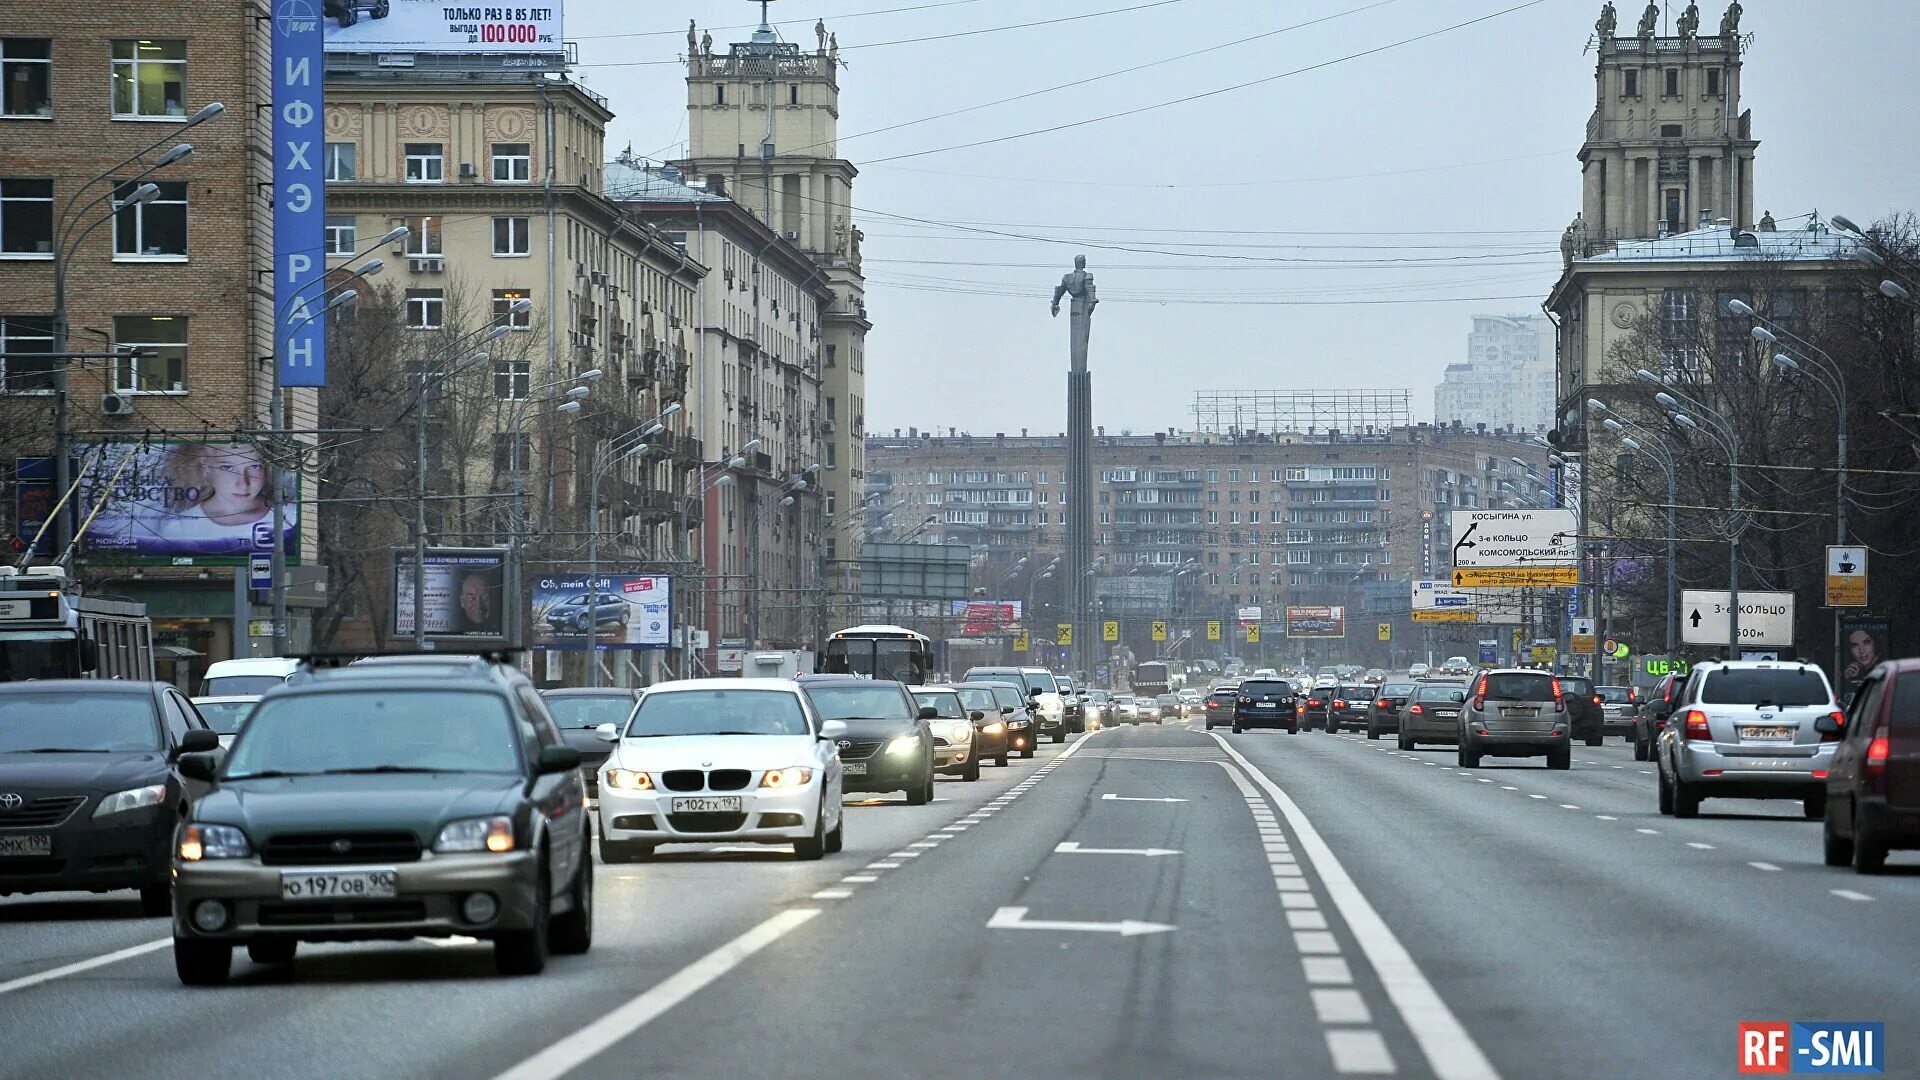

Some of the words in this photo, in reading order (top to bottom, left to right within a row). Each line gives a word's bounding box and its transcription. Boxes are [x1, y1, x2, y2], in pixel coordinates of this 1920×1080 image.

[443, 8, 481, 21] ТОЛЬКО
[485, 8, 502, 21] РАЗ
[506, 8, 513, 20] В
[515, 8, 527, 20] 85
[529, 8, 552, 21] ЛЕТ!
[449, 24, 478, 34] ВЫГОДА
[468, 35, 478, 44] ДО
[480, 24, 505, 43] 100
[508, 24, 536, 43] 000
[283, 57, 314, 213] ИФХЭ
[287, 254, 314, 367] РАН
[1493, 535, 1528, 543] КОЛЬЦО
[1479, 548, 1557, 557] КОМСОМОЛЬСКИЙ
[540, 579, 558, 589] Oh,
[560, 580, 584, 588] mein
[1739, 605, 1786, 616] КОЛЬЦО
[676, 799, 719, 811] Р102ТХ
[721, 798, 737, 807] 197
[288, 876, 365, 896] О197ОВ
